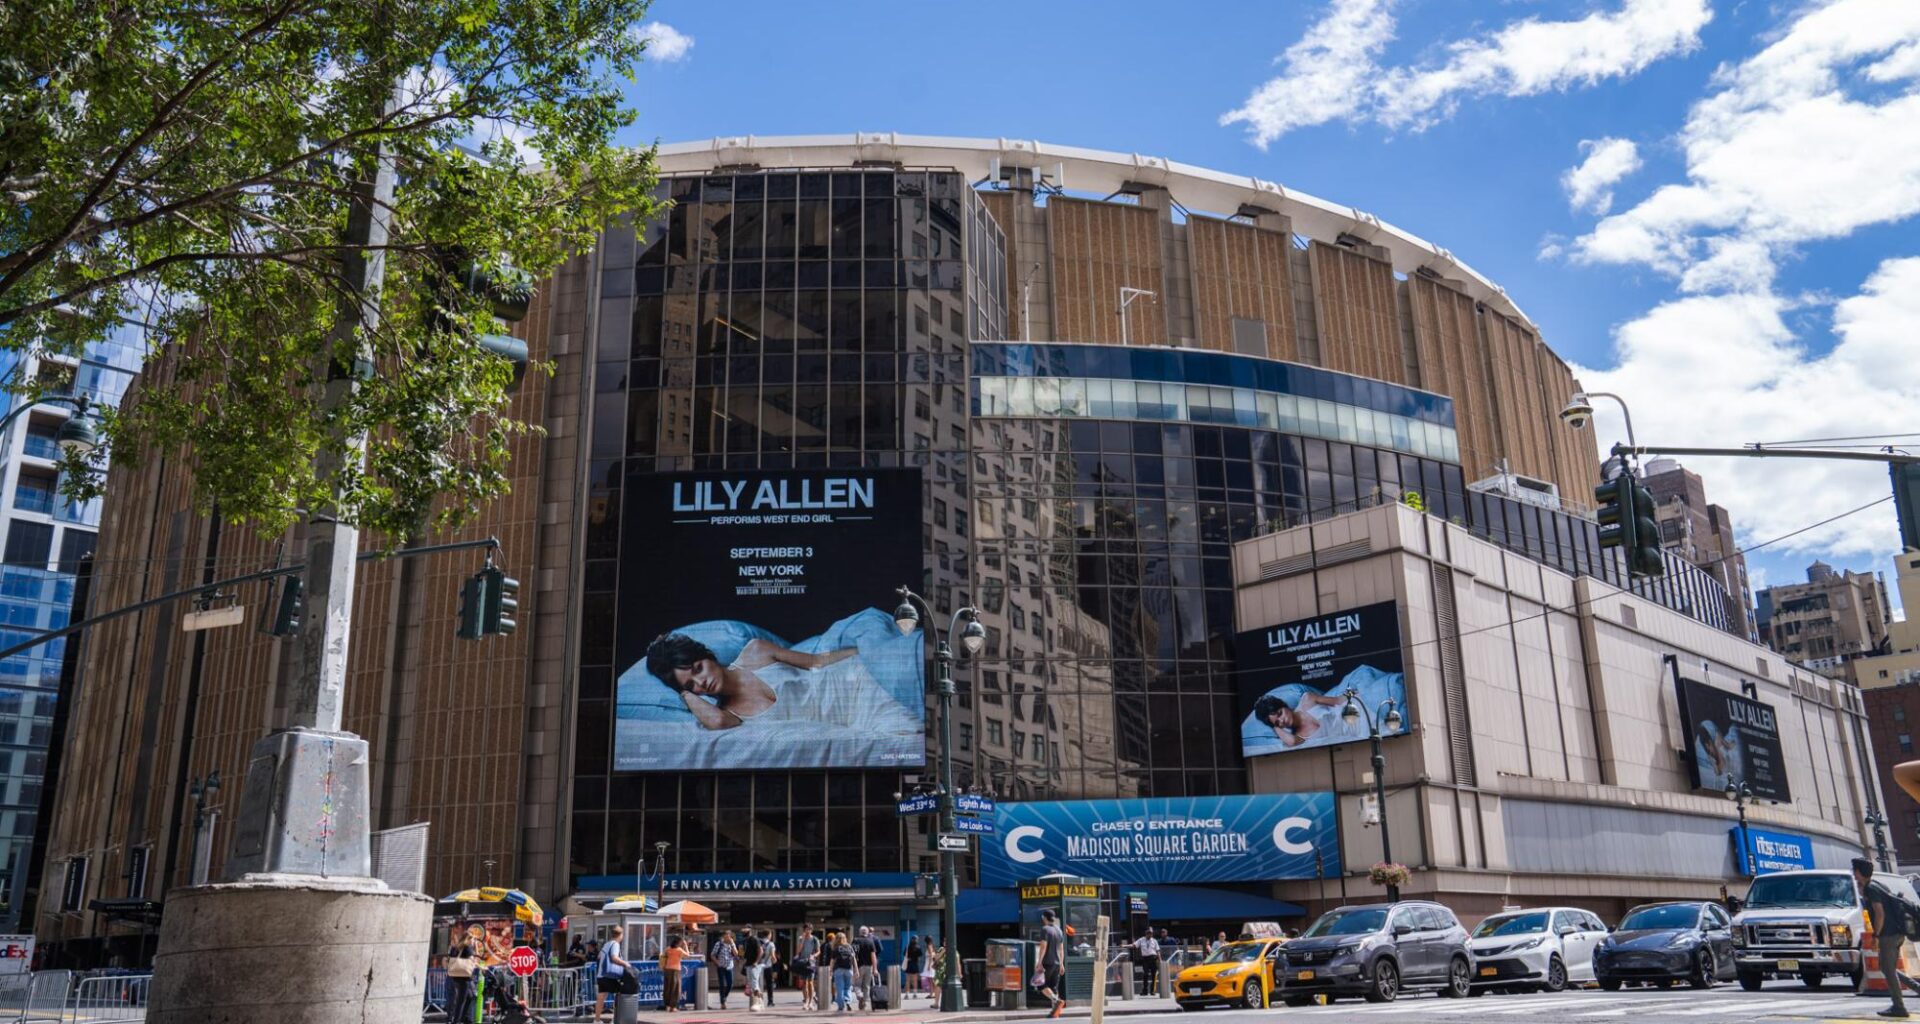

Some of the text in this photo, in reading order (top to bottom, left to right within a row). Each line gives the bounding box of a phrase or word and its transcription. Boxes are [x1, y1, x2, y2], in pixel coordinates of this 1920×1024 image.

[673, 478, 874, 511] LILY ALLEN
[711, 514, 834, 525] PERFORMS WEST END GIRL
[730, 547, 813, 559] SEPTEMBER 3
[739, 565, 804, 576] NEW YORK
[1267, 613, 1361, 648] LILY ALLEN
[1297, 650, 1329, 662] SEPTEMBER
[1302, 662, 1315, 671] NEW
[1726, 698, 1776, 732] LILY ALLEN
[899, 803, 915, 813] West
[928, 799, 936, 809] St
[958, 799, 992, 811] Eighth Ave
[959, 821, 968, 829] Joe
[969, 821, 983, 831] Louis
[1092, 818, 1223, 832] CHASE ENTRANCE
[1272, 816, 1314, 855] C
[1005, 825, 1046, 863] C
[1067, 831, 1247, 857] MADISON SQUARE GARDEN
[662, 878, 852, 890] PENNSYLVANIA STATION
[1023, 886, 1047, 898] TAXI
[1065, 885, 1086, 896] TAXI
[0, 944, 28, 959] dEx
[511, 955, 536, 968] STOP
[638, 983, 664, 992] ELCOME
